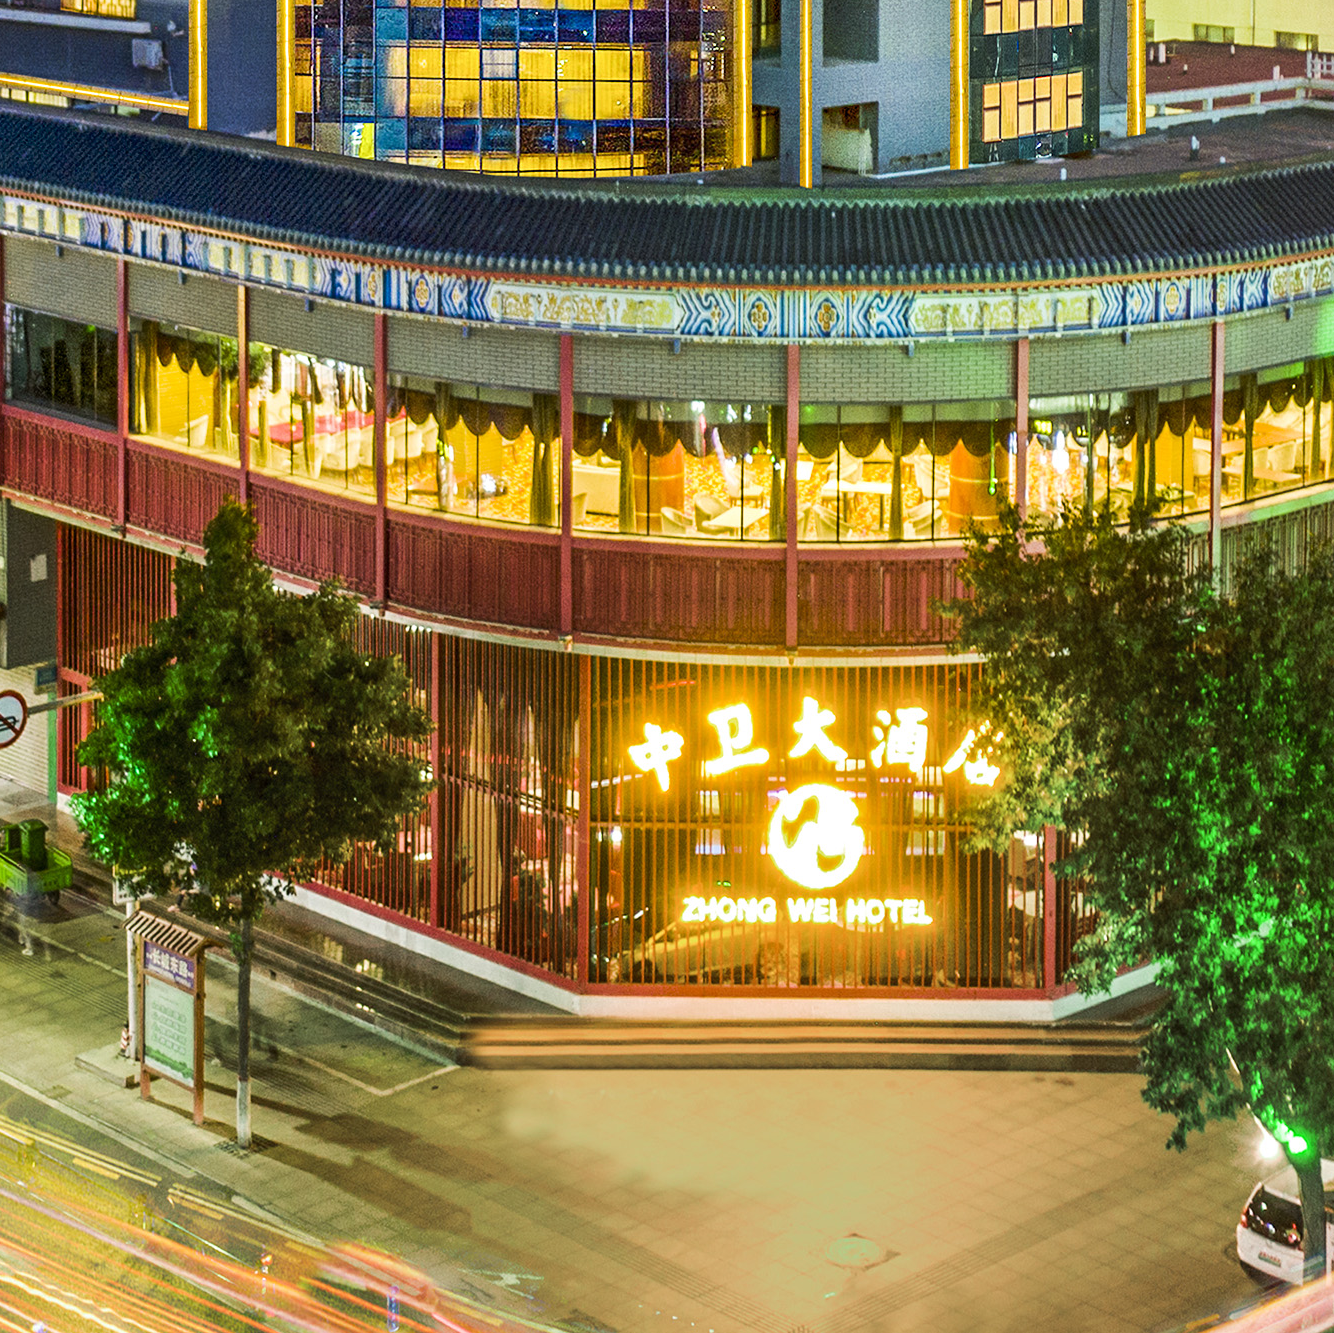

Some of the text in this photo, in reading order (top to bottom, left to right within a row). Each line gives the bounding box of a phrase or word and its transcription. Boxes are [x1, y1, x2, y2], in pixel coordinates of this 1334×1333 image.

[681, 896, 933, 926] ZHONG WEI HOTEL
